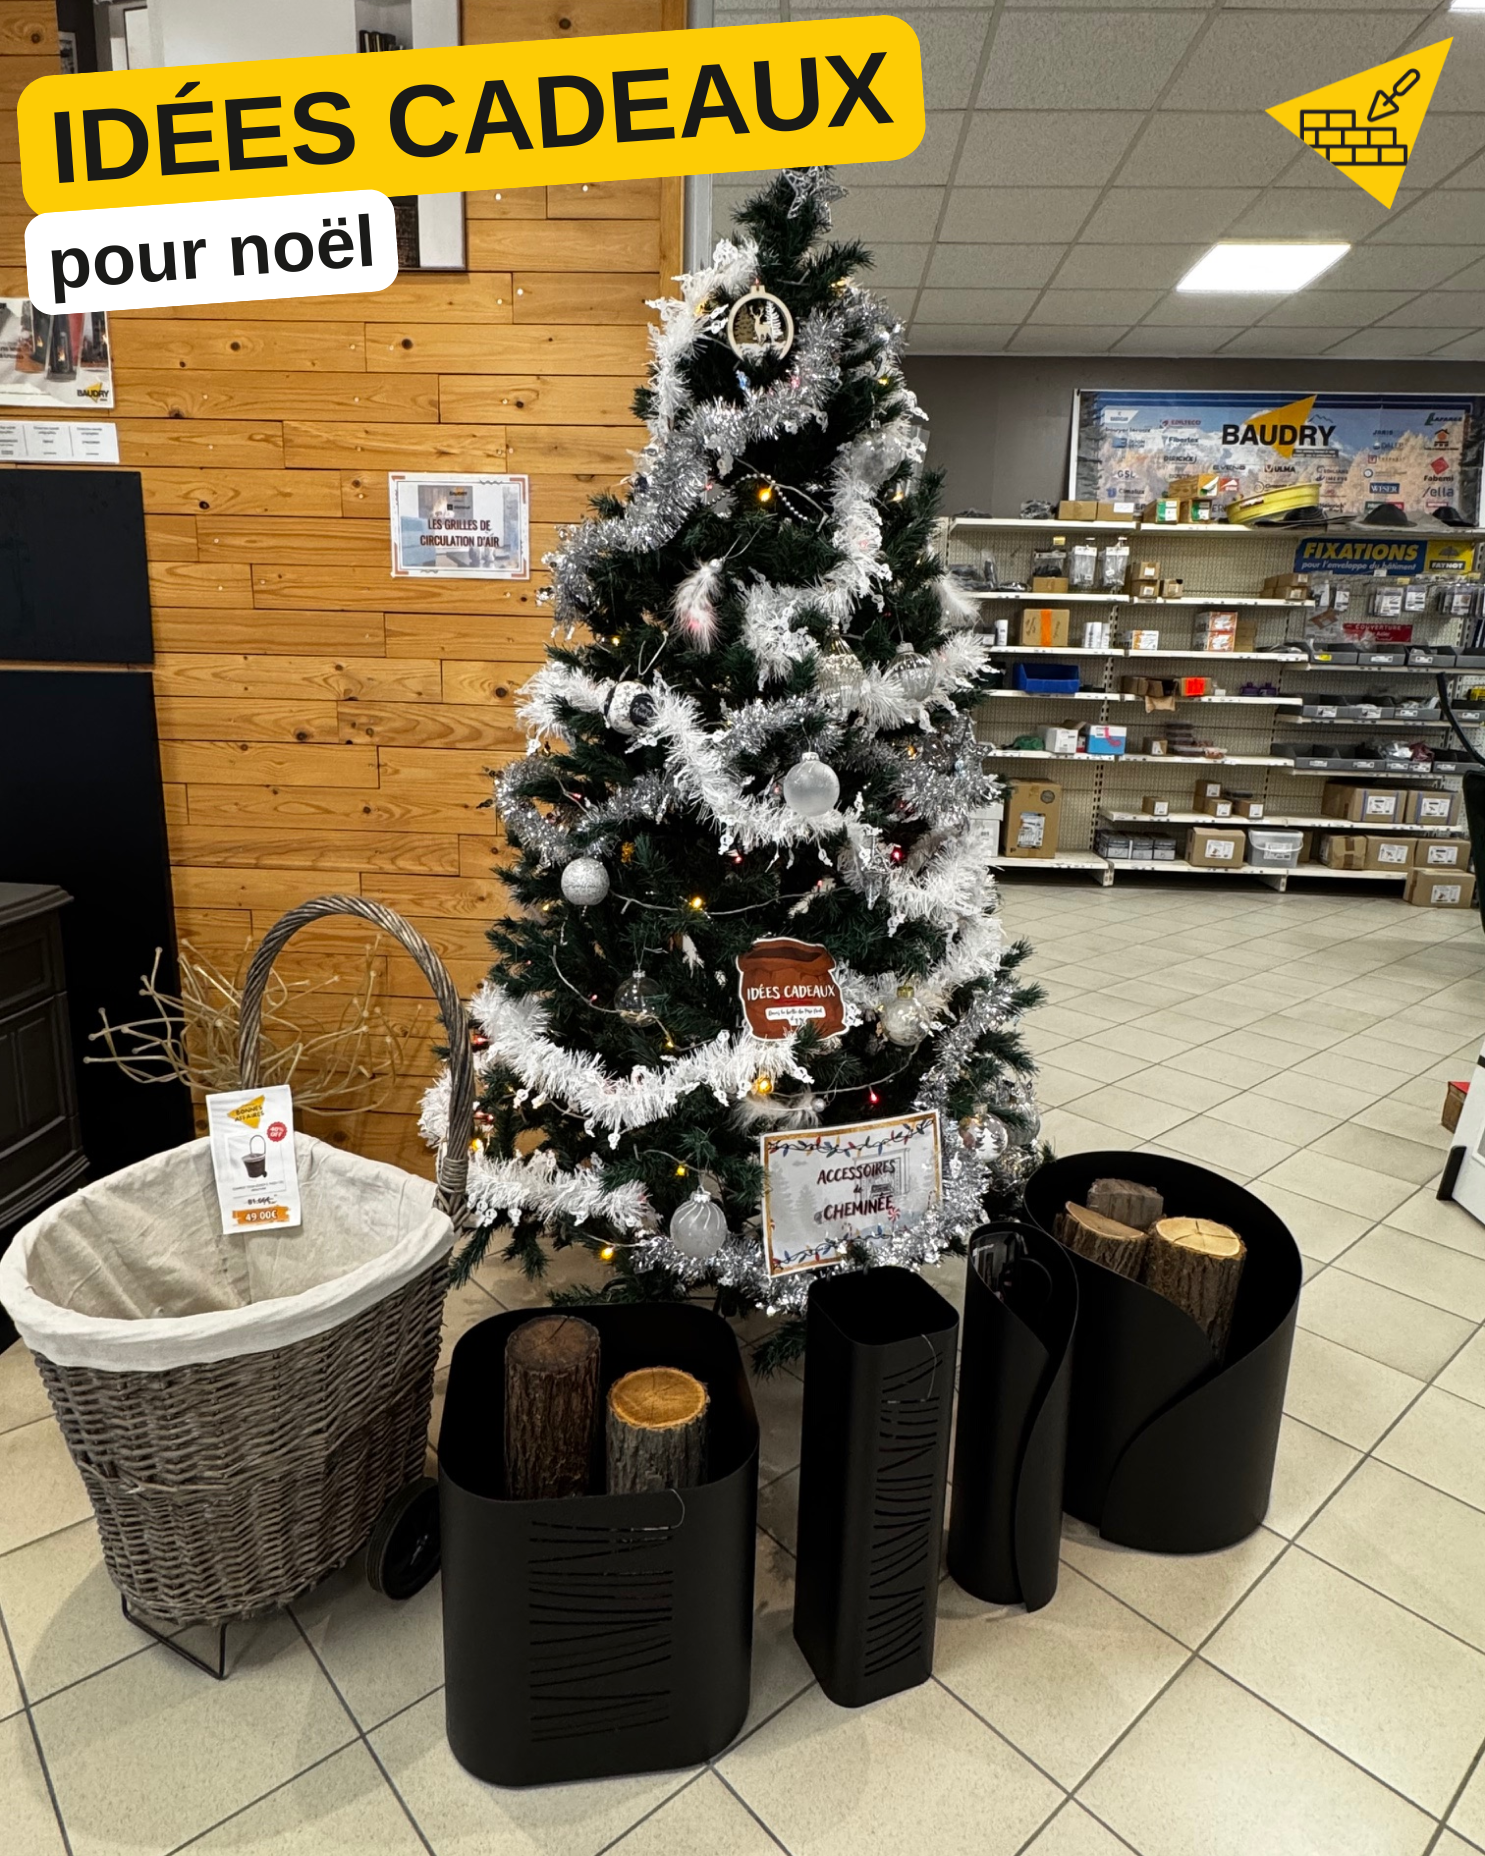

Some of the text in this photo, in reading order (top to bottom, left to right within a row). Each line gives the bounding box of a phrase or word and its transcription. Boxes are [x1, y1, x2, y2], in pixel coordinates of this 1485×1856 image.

[77, 389, 109, 398] BAUDRY
[1222, 424, 1337, 446] BAUDRY
[1117, 470, 1136, 478] GSL
[428, 519, 491, 531] LES GRILLES DE
[420, 535, 500, 548] CIRCULATION D'AIR
[1303, 542, 1419, 561] FIXATIONS
[1301, 561, 1320, 570] pour
[1322, 560, 1367, 571] l'enveloppe
[1369, 561, 1380, 569] du
[747, 983, 835, 1001] IDÉES CADEAUX
[817, 1159, 896, 1185] ACCESSOIRES
[823, 1193, 894, 1221] CHEMINÉE
